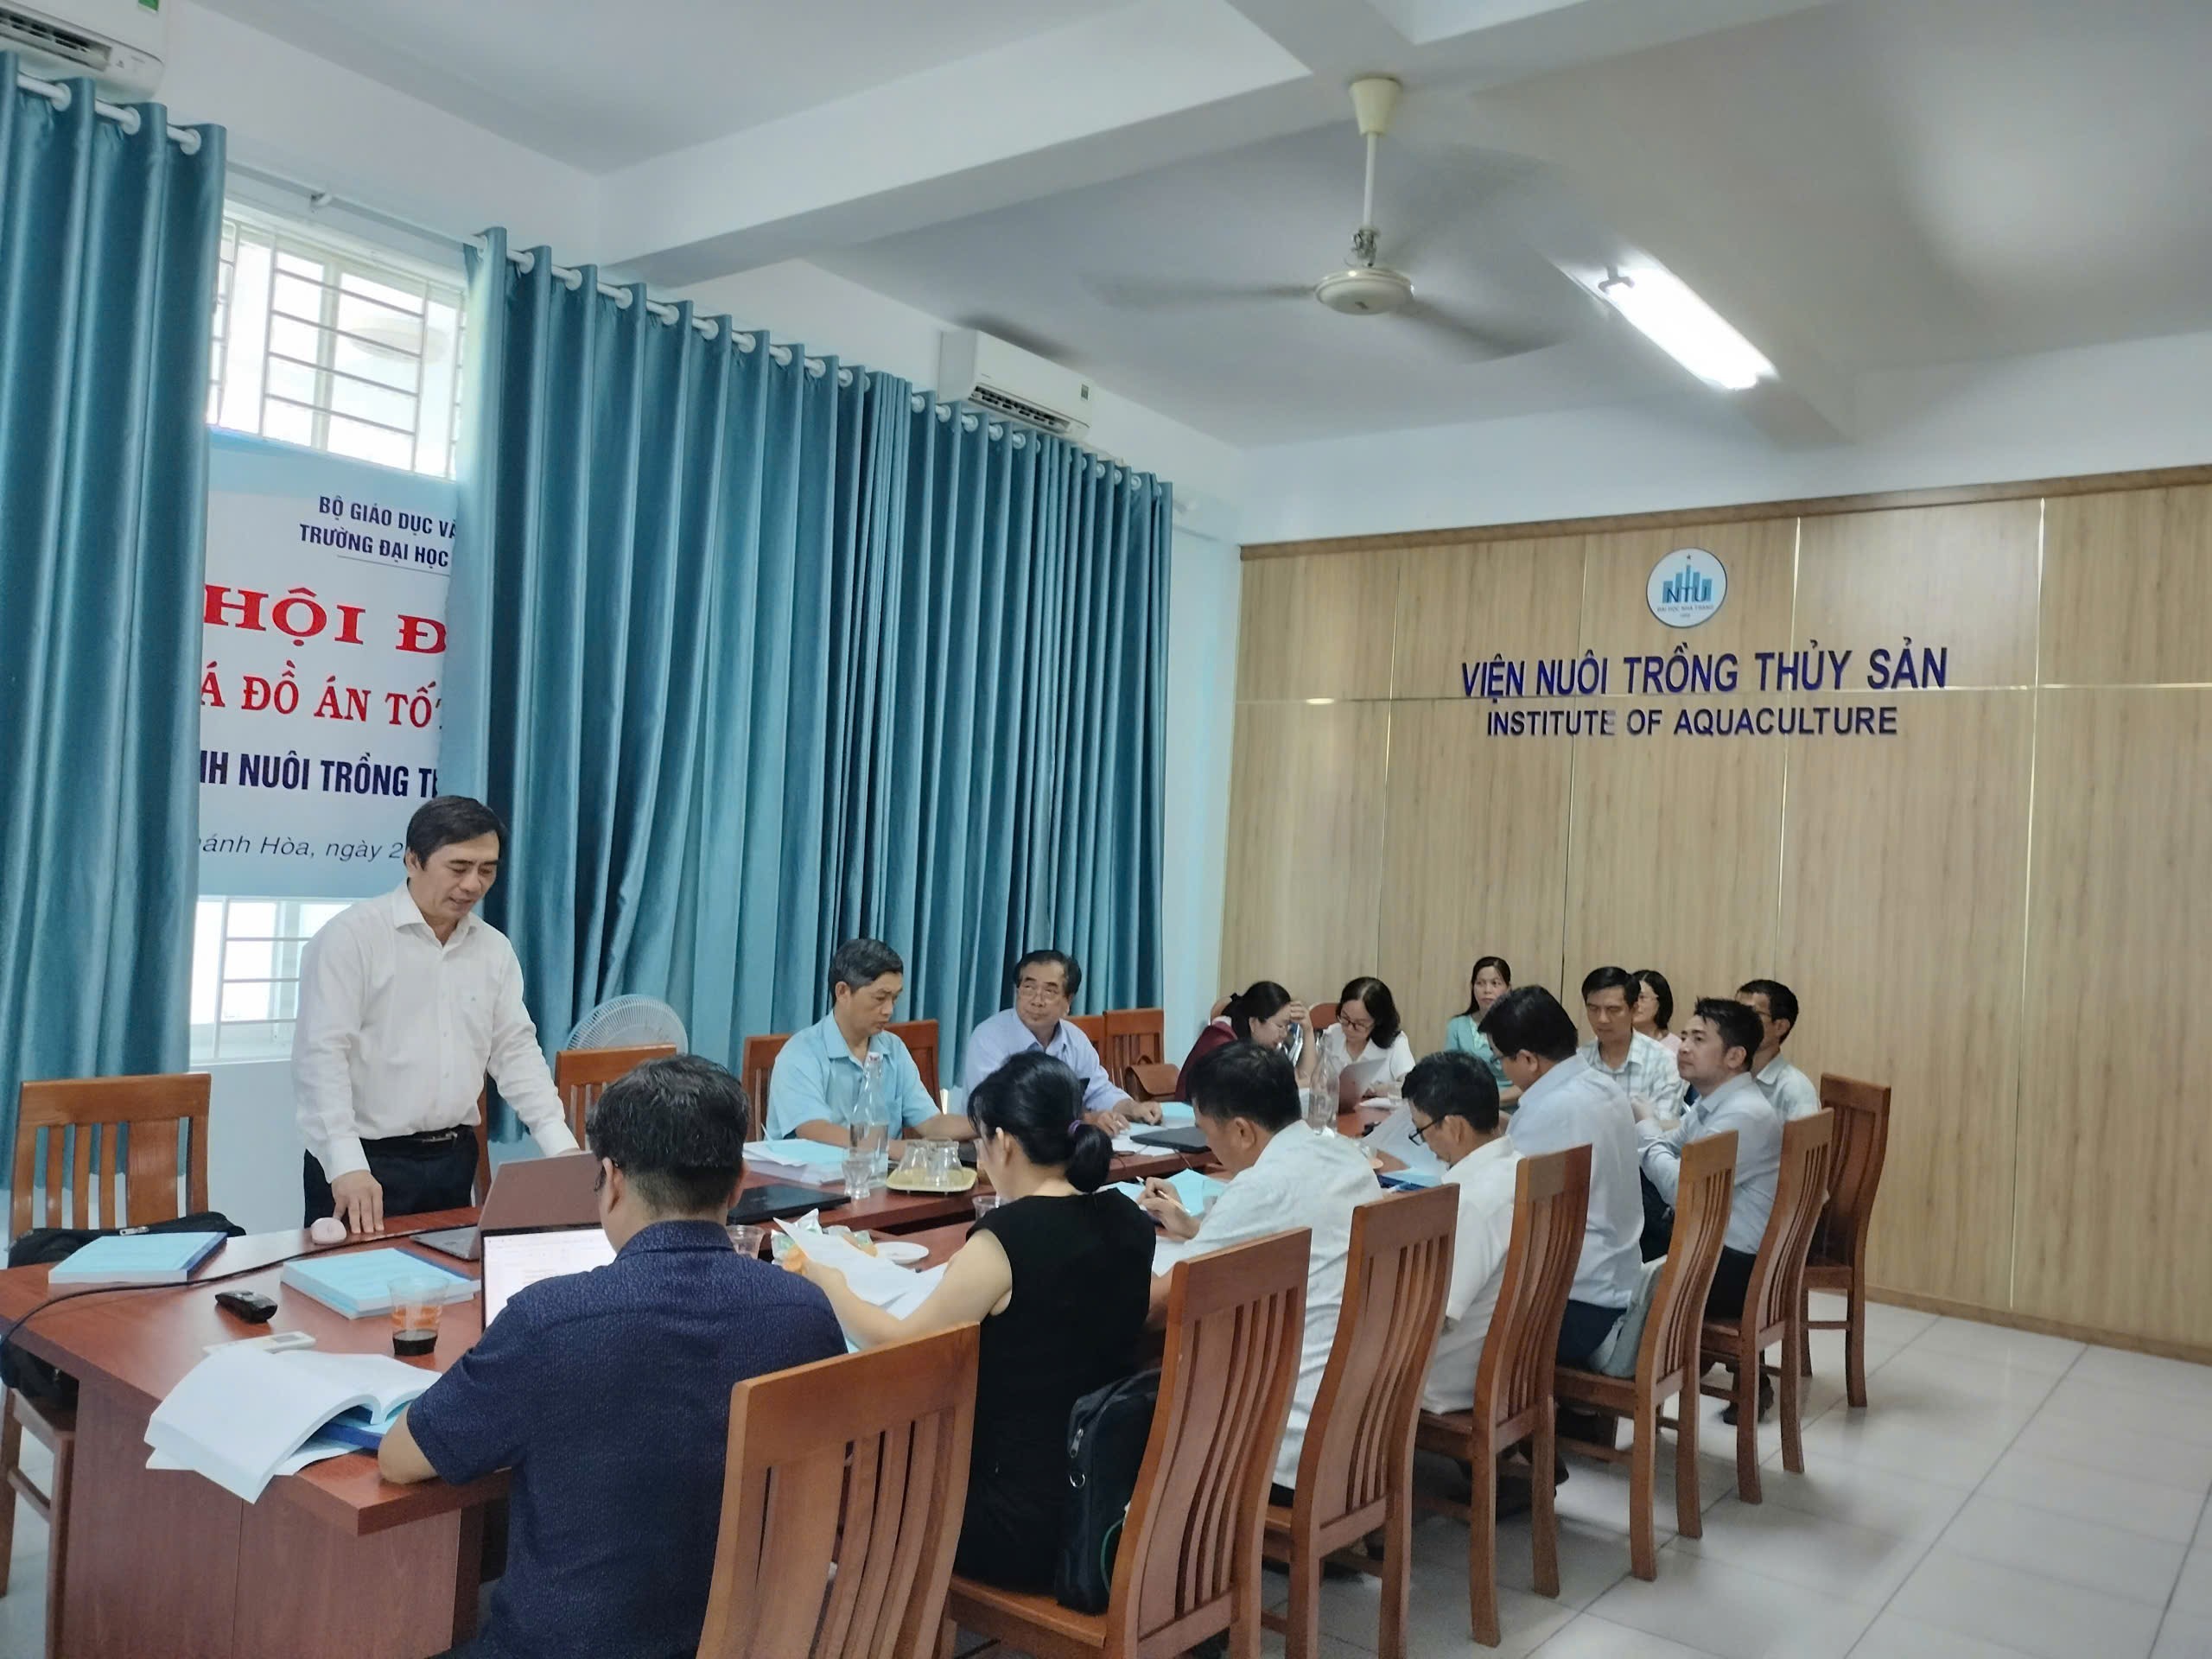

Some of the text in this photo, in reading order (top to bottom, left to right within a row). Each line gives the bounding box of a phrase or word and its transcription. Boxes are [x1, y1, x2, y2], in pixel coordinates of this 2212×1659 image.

[319, 495, 344, 520] BỘ
[350, 502, 392, 526] GIÁO
[397, 512, 433, 536] DỤC
[299, 523, 449, 569] TRƯỜNG ĐẠI HỌC
[1667, 587, 1707, 603] NTU
[204, 584, 447, 654] HỘI Đ
[1462, 636, 1948, 703] VIỆN NUÔI TRỒNG THỦY SẢN
[241, 660, 299, 715] ĐỒ
[314, 675, 372, 722] ÁN
[385, 681, 442, 729] TỐ
[1487, 706, 1898, 737] INSTITUTE OF AQUACULTURE
[238, 750, 310, 791] NUÔI
[321, 752, 410, 797] TRỒNG
[199, 834, 404, 862] ánh Hòa, ngày 2
